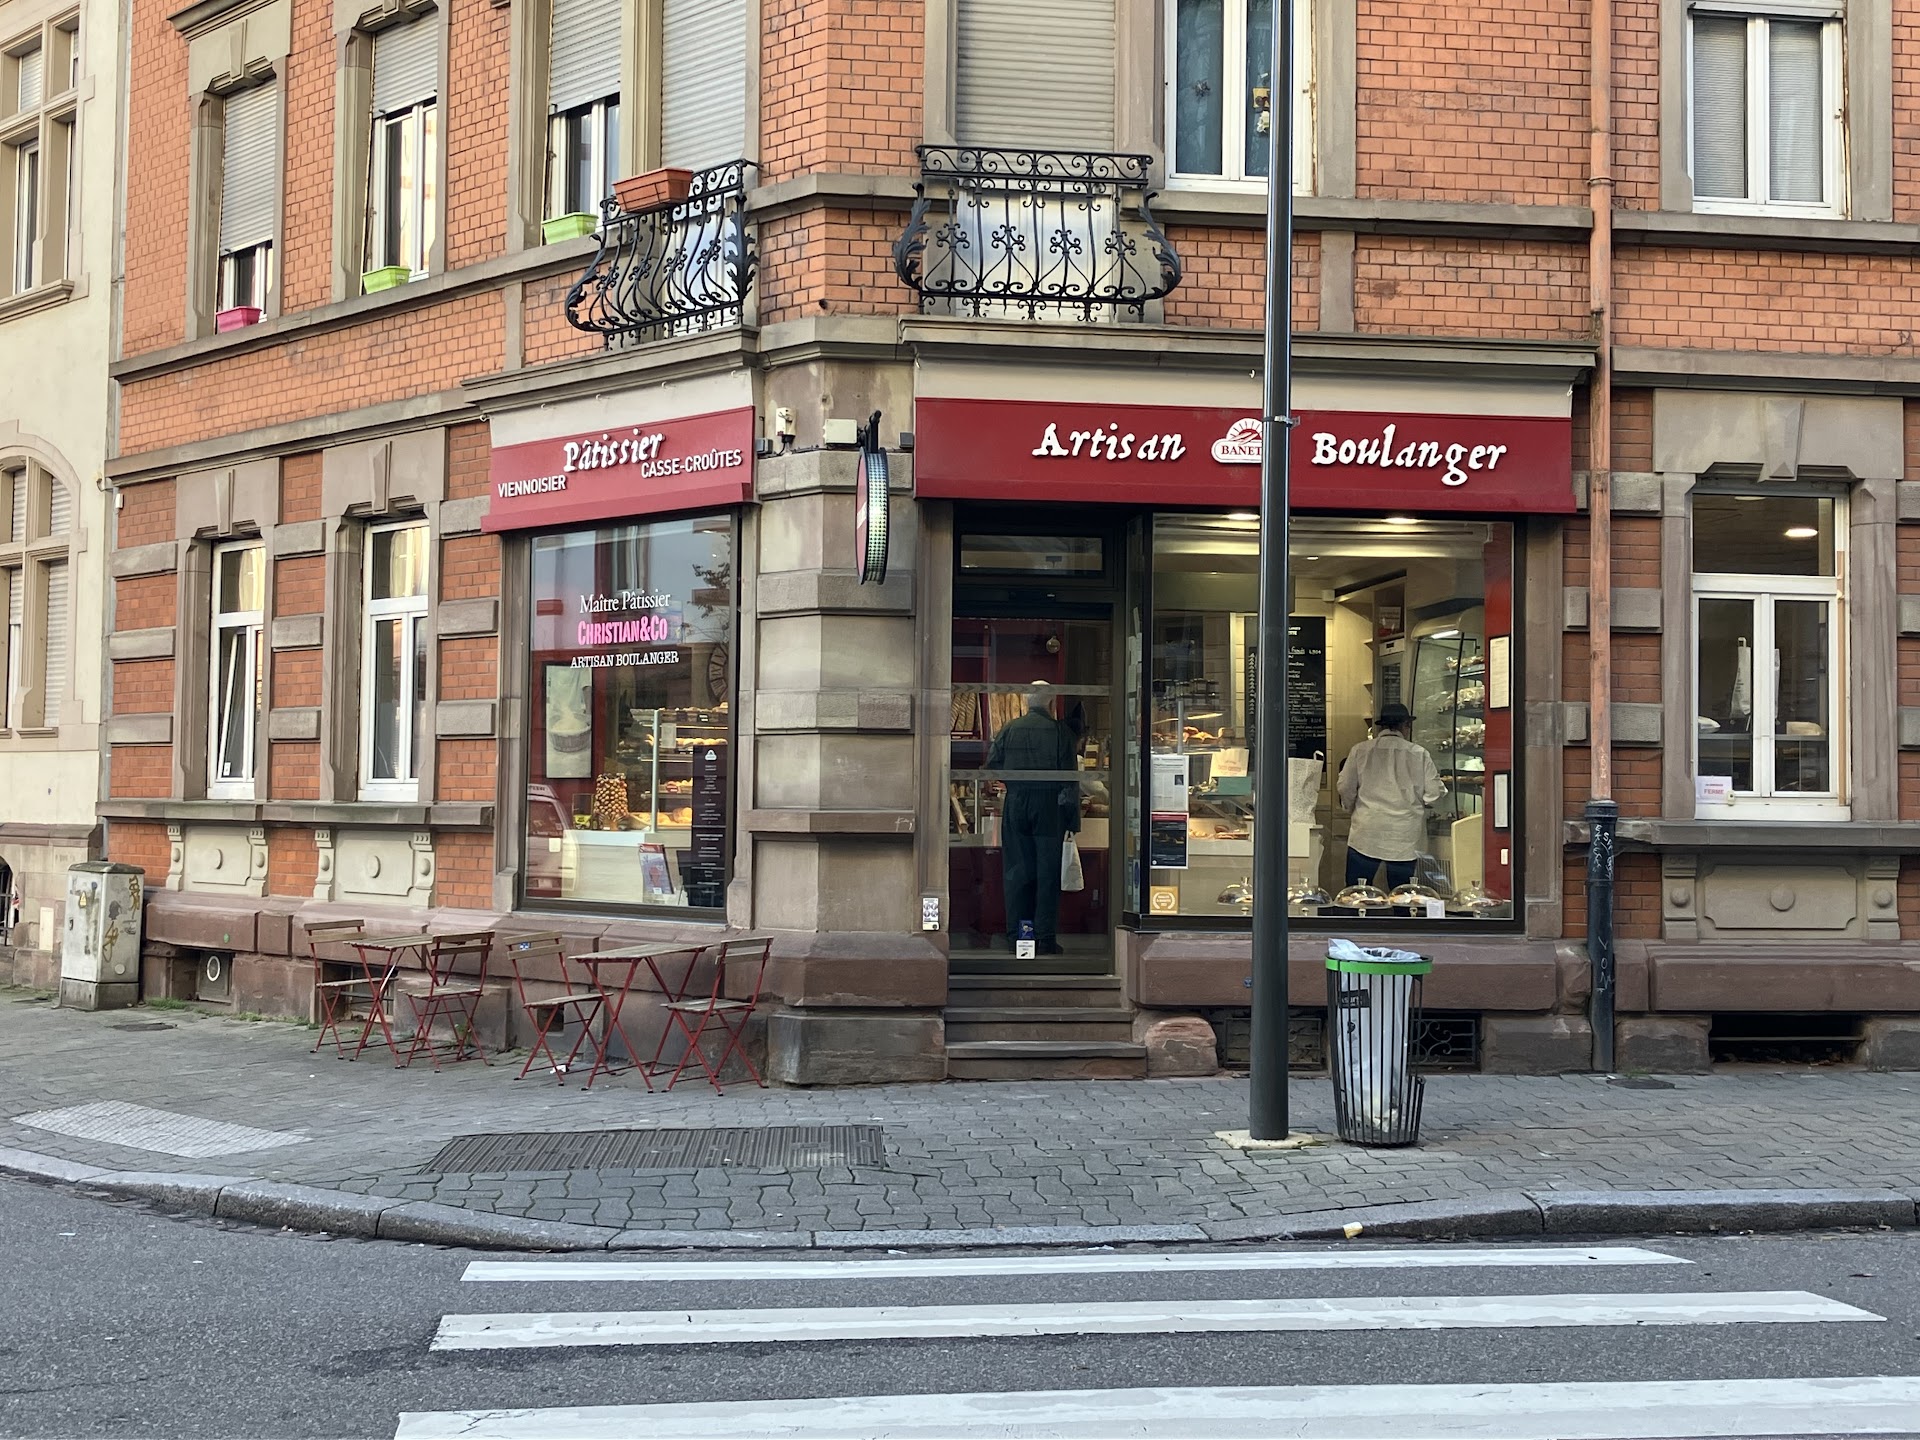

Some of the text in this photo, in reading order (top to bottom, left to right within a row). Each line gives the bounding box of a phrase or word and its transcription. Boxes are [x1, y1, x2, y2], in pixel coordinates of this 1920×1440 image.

[563, 428, 665, 472] Pâtissier
[1032, 422, 1508, 486] Artisan Boulanger
[1222, 445, 1262, 455] BANET
[641, 448, 743, 479] CASSE-CROÛTES
[498, 474, 567, 498] VIENNOISIER
[579, 588, 671, 614] Maître Pâtissier
[570, 650, 679, 668] ARTISAN BOULANGER
